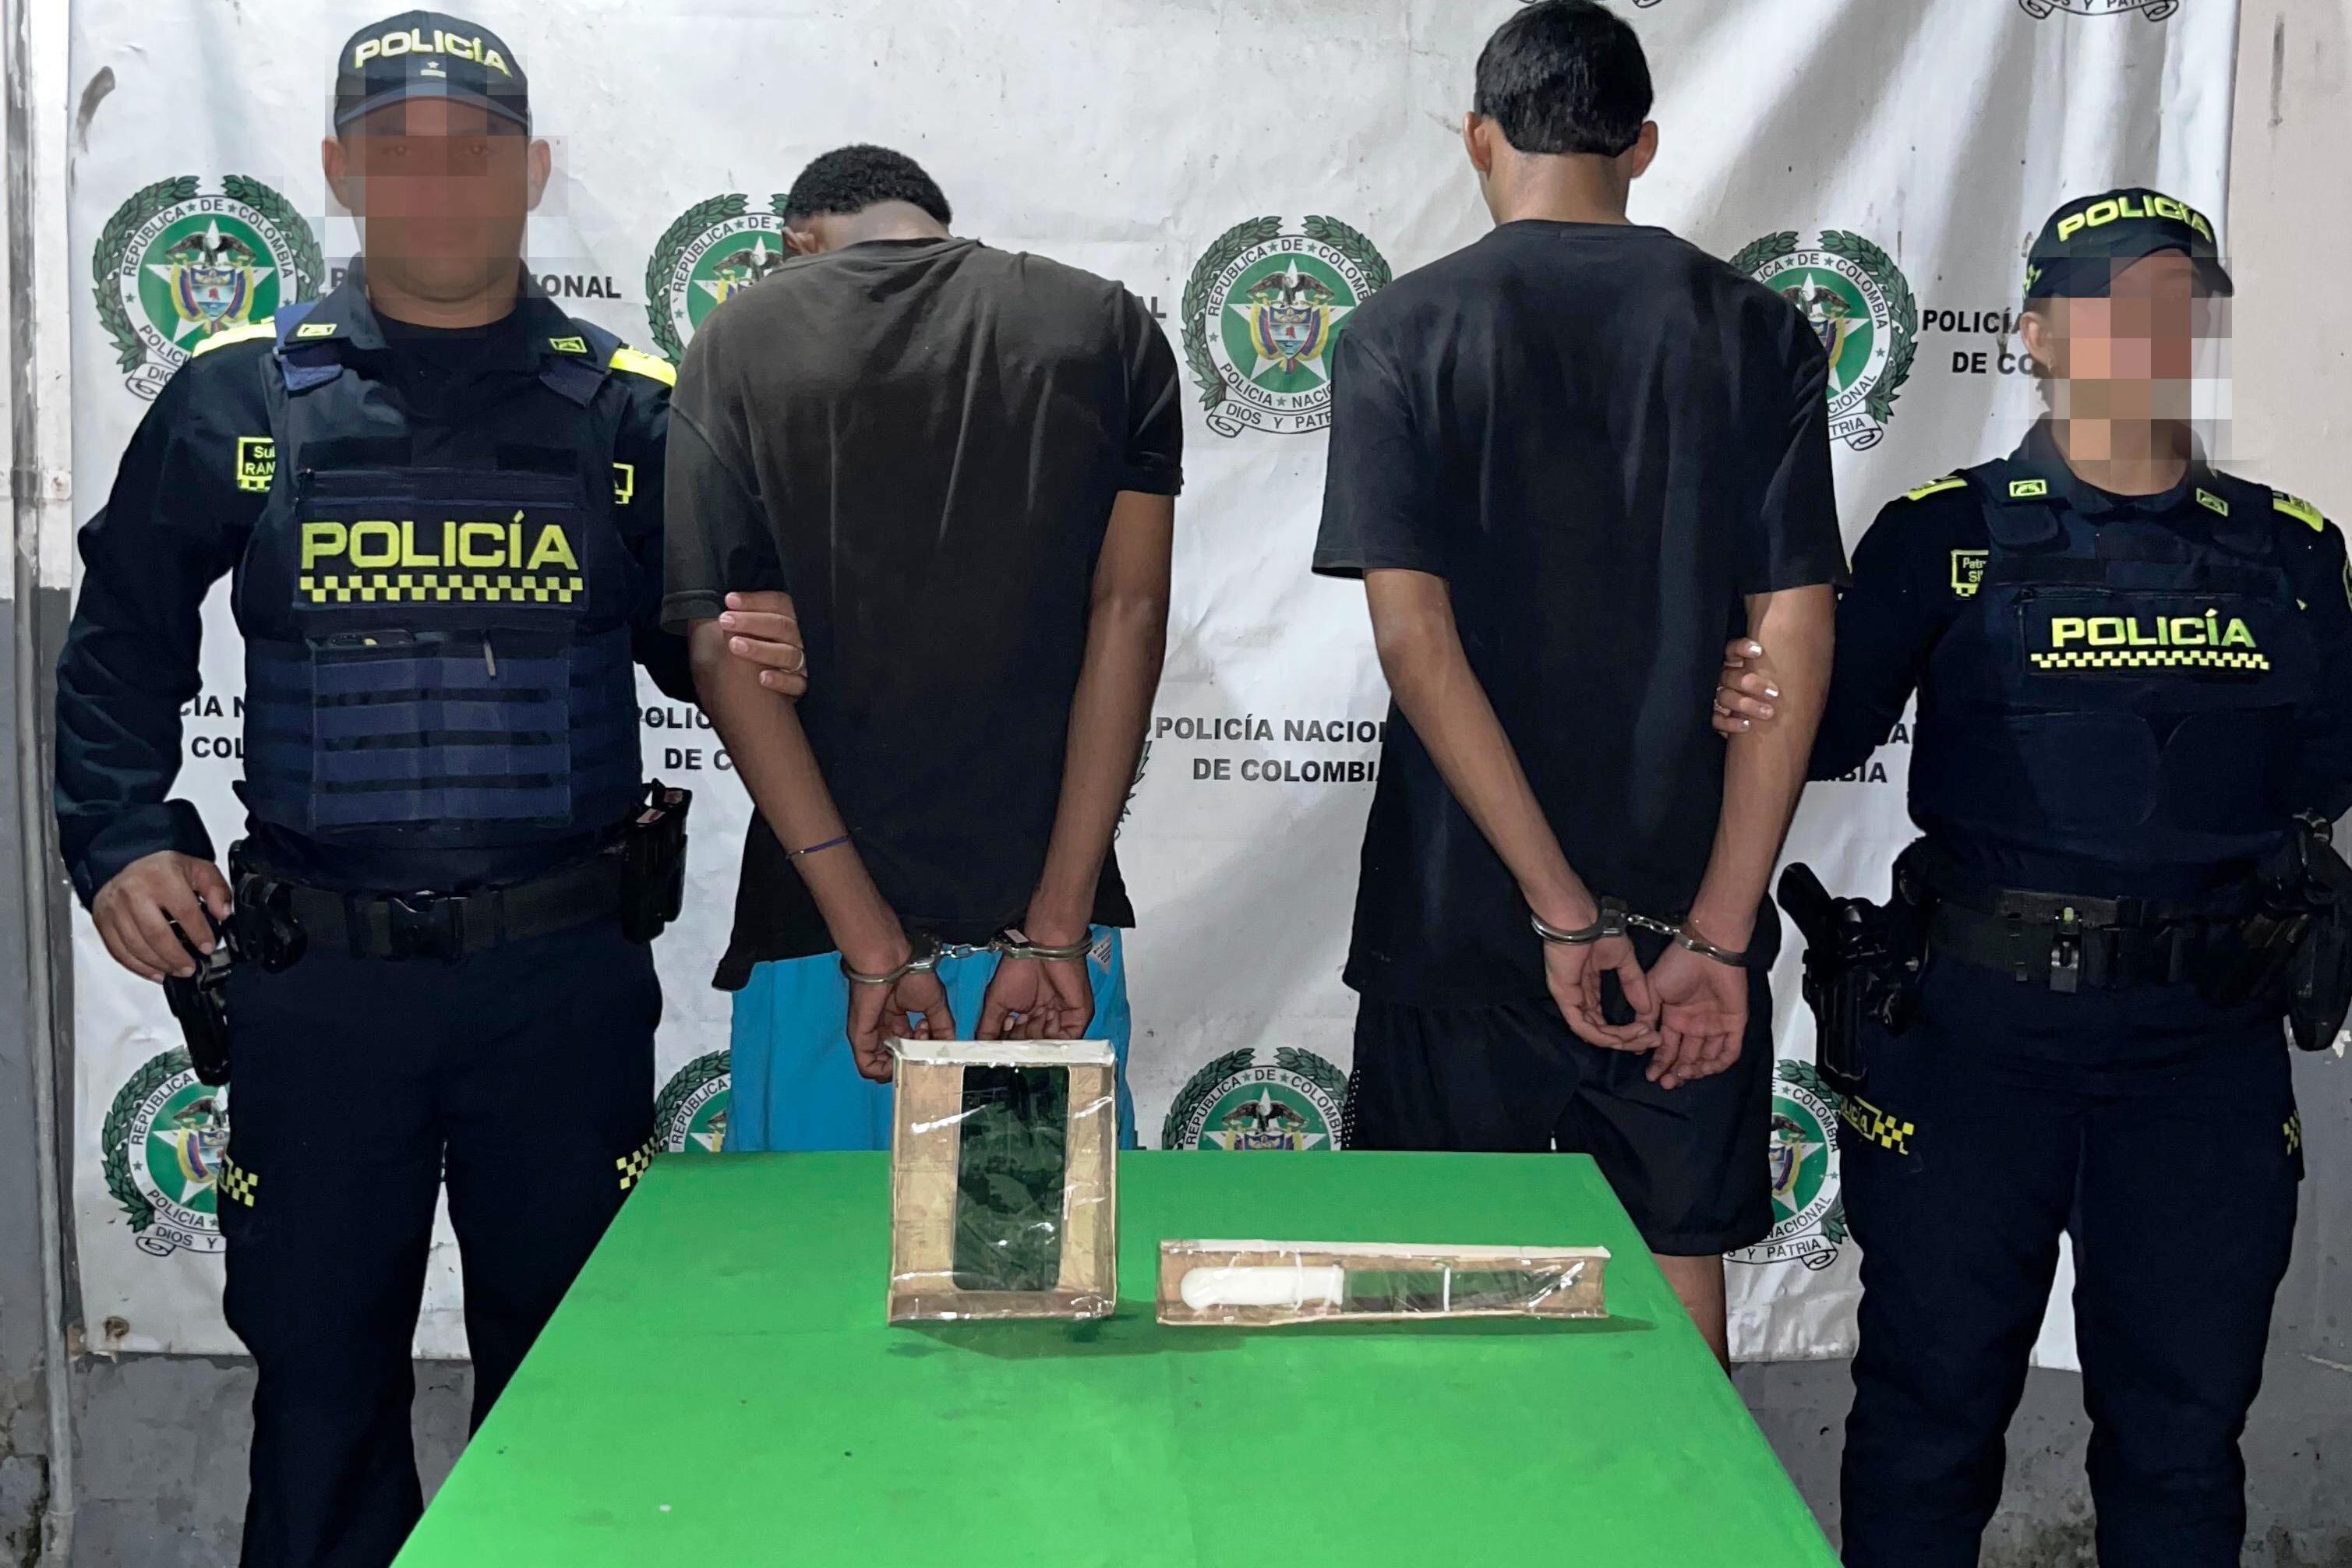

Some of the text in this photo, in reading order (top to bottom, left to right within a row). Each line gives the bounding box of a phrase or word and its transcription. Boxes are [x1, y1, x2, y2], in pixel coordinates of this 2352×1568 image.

[123, 199, 295, 279] REPUBLICA DE COLOMBIA
[673, 217, 771, 293] REPUBLICA DE
[532, 274, 622, 298] ONAL
[1208, 246, 1268, 316] REPUBLICA
[1281, 239, 1303, 251] DE
[1319, 246, 1370, 301] COLOMB
[1797, 253, 1888, 330] DE COLOMBIA
[139, 324, 188, 363] POLICI
[1952, 351, 1986, 373] DE
[1220, 362, 1273, 406] POLICIA
[1828, 376, 1877, 414] CIONAL
[1226, 403, 1262, 425] DIOS
[1273, 416, 1284, 429] Y
[1828, 417, 1866, 436] TRIA
[301, 509, 579, 571] POLICÍA
[2051, 608, 2258, 648] POLICÍA
[1155, 714, 1386, 743] POLICÍA NACIO
[665, 747, 703, 770] DE
[1193, 758, 1378, 783] DE COLOMBI
[131, 1072, 194, 1146] REPUBLICA
[671, 1078, 728, 1145] REPUBLICA
[1185, 1068, 1342, 1146] REPUBLICA DE COLOMBIA
[1792, 1088, 1840, 1153] COLOMBIA
[147, 1189, 205, 1227] POLICIA
[155, 1226, 217, 1249] DIOS Y
[1746, 1248, 1756, 1260] Y
[1767, 1238, 1822, 1259] PATRIA
